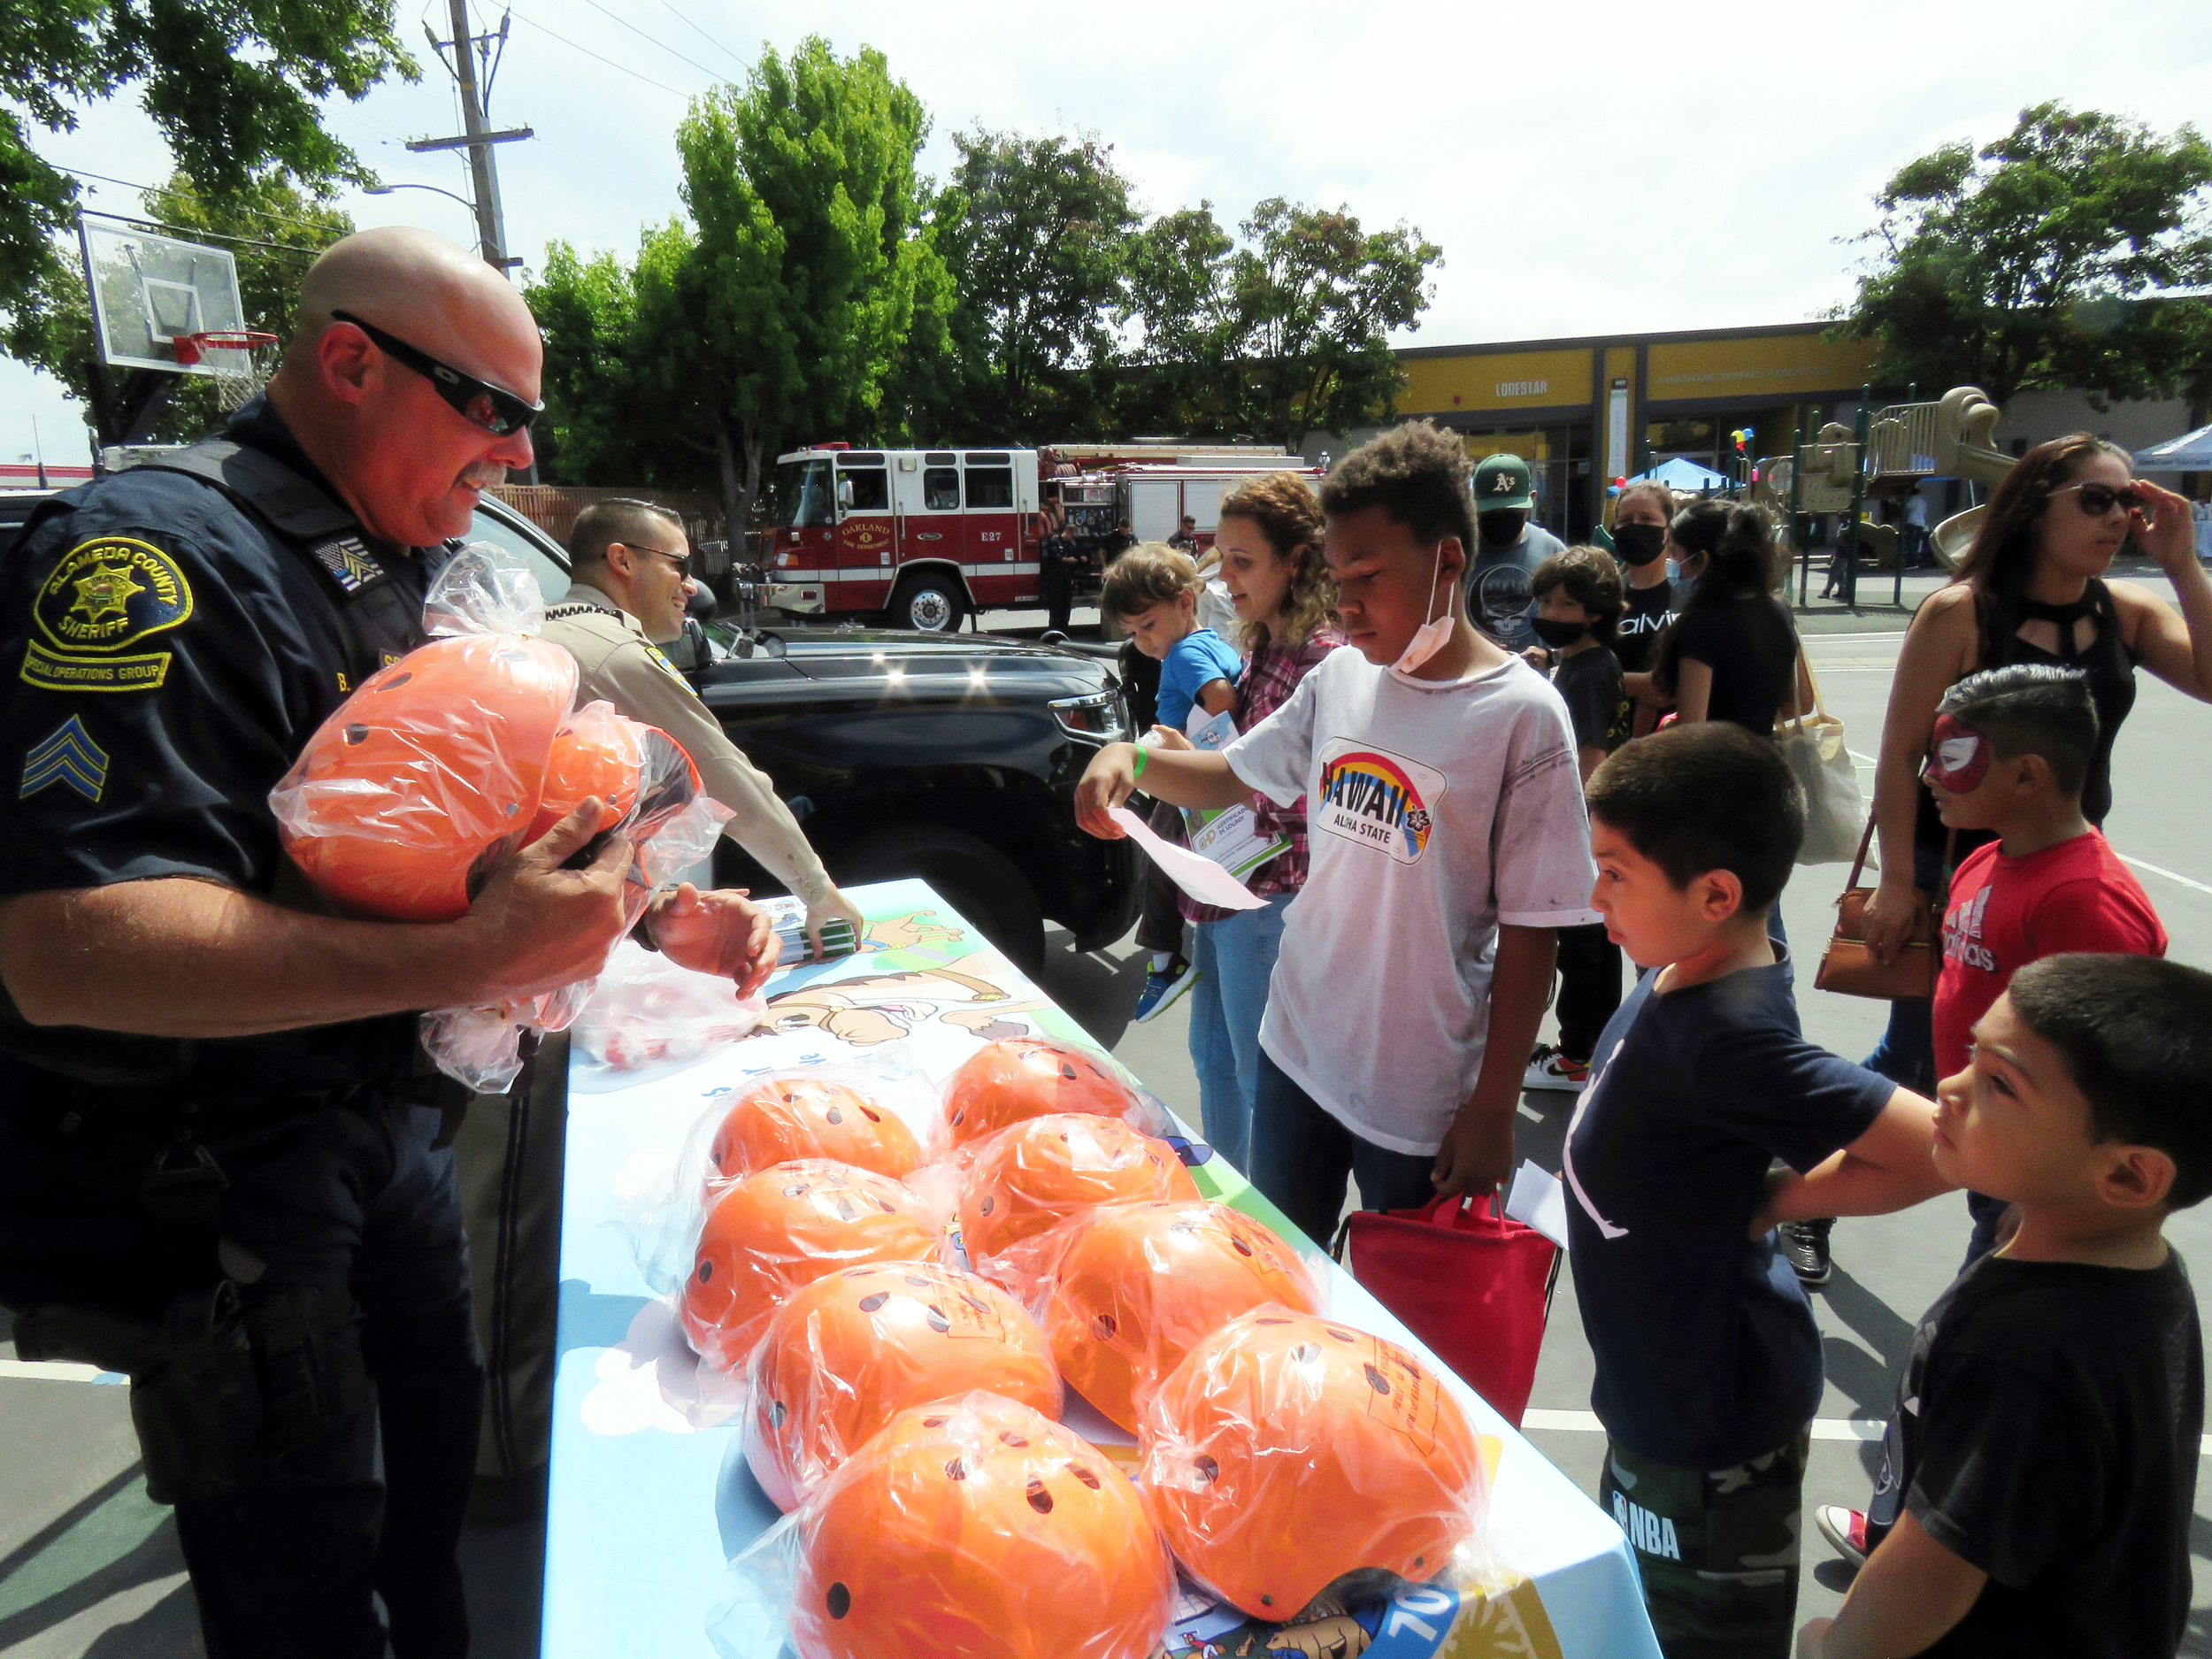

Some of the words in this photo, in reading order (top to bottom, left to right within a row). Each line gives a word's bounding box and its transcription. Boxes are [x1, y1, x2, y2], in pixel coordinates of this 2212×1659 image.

[1495, 380, 1548, 397] LODESTAR
[1493, 472, 1516, 492] A's
[841, 523, 890, 535] OAKLAND
[980, 532, 1002, 541] E27
[49, 546, 131, 595] ALAMEDA
[132, 551, 179, 605] COUNTY
[58, 615, 129, 640] SHERIFF
[52, 666, 114, 680] OPERATIONS
[119, 664, 159, 680] GROUP
[1322, 762, 1410, 829] HAWAII
[1218, 827, 1226, 836] DE
[1333, 813, 1357, 833] ALOHA
[1359, 823, 1392, 844] STATE
[1629, 1501, 1681, 1561] NBA
